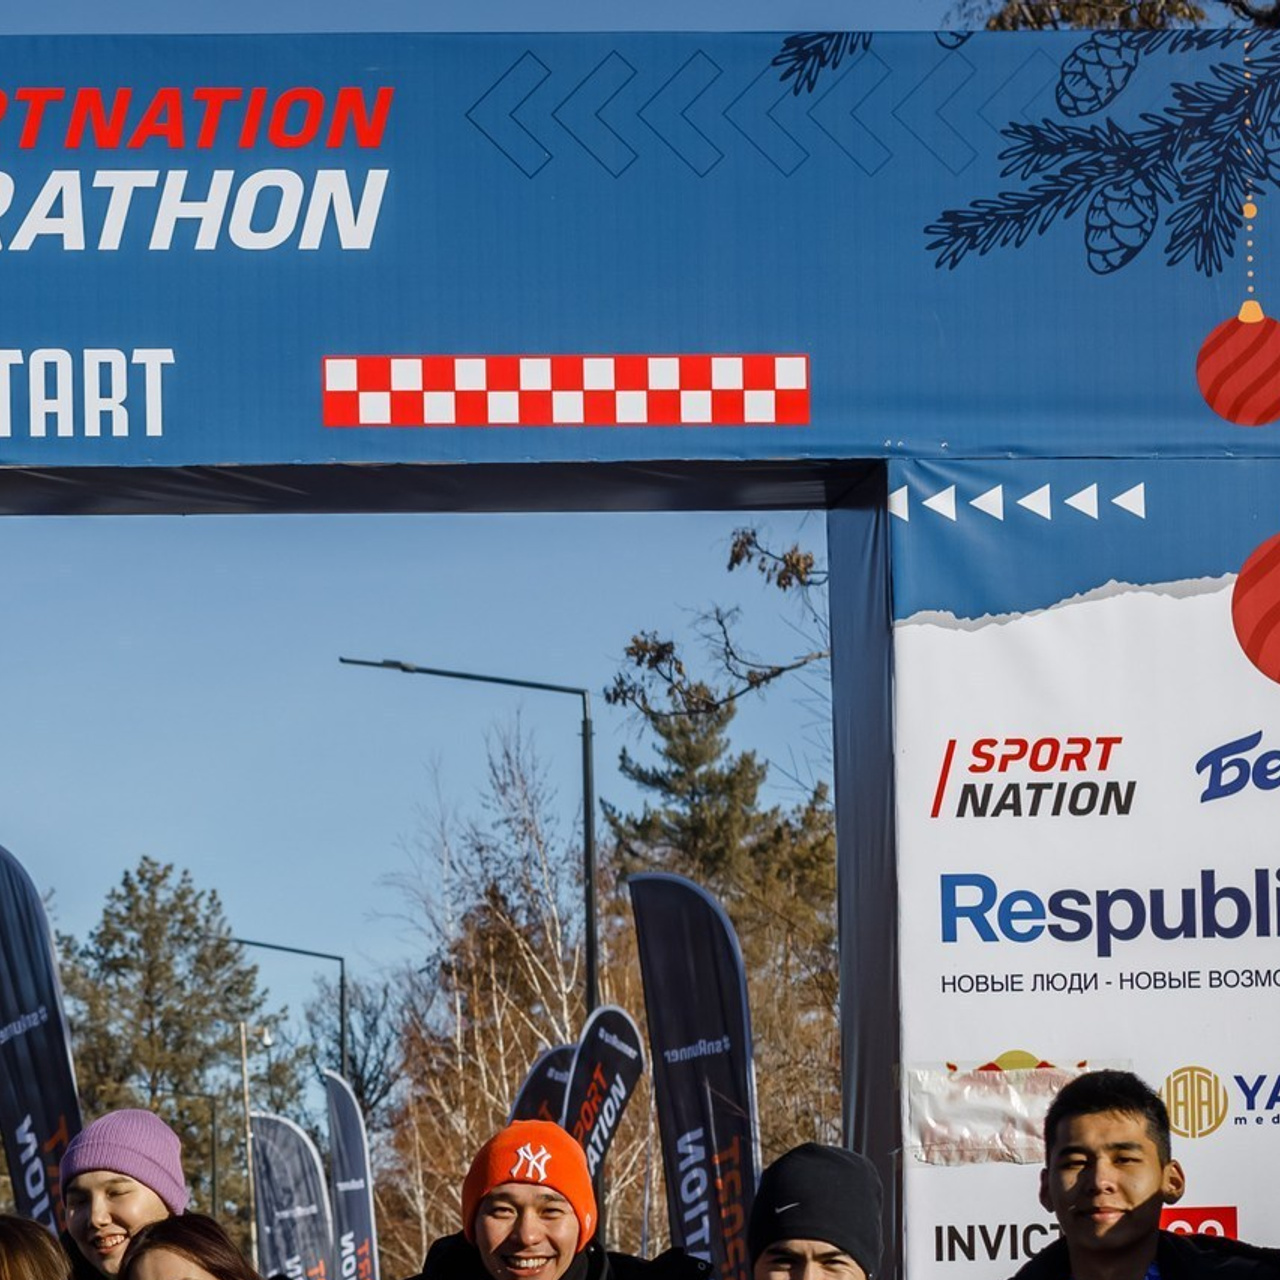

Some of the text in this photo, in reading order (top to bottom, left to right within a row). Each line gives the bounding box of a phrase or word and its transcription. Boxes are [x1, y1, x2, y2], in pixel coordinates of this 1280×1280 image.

[968, 736, 1123, 773] SPORT
[956, 780, 1137, 817] NATION
[941, 974, 1023, 993] НОВЫЕ
[1031, 972, 1099, 994] ЛЮДИ
[1119, 971, 1201, 991] НОВЫЕ
[586, 1073, 627, 1177] ATION
[510, 1142, 552, 1182] NY
